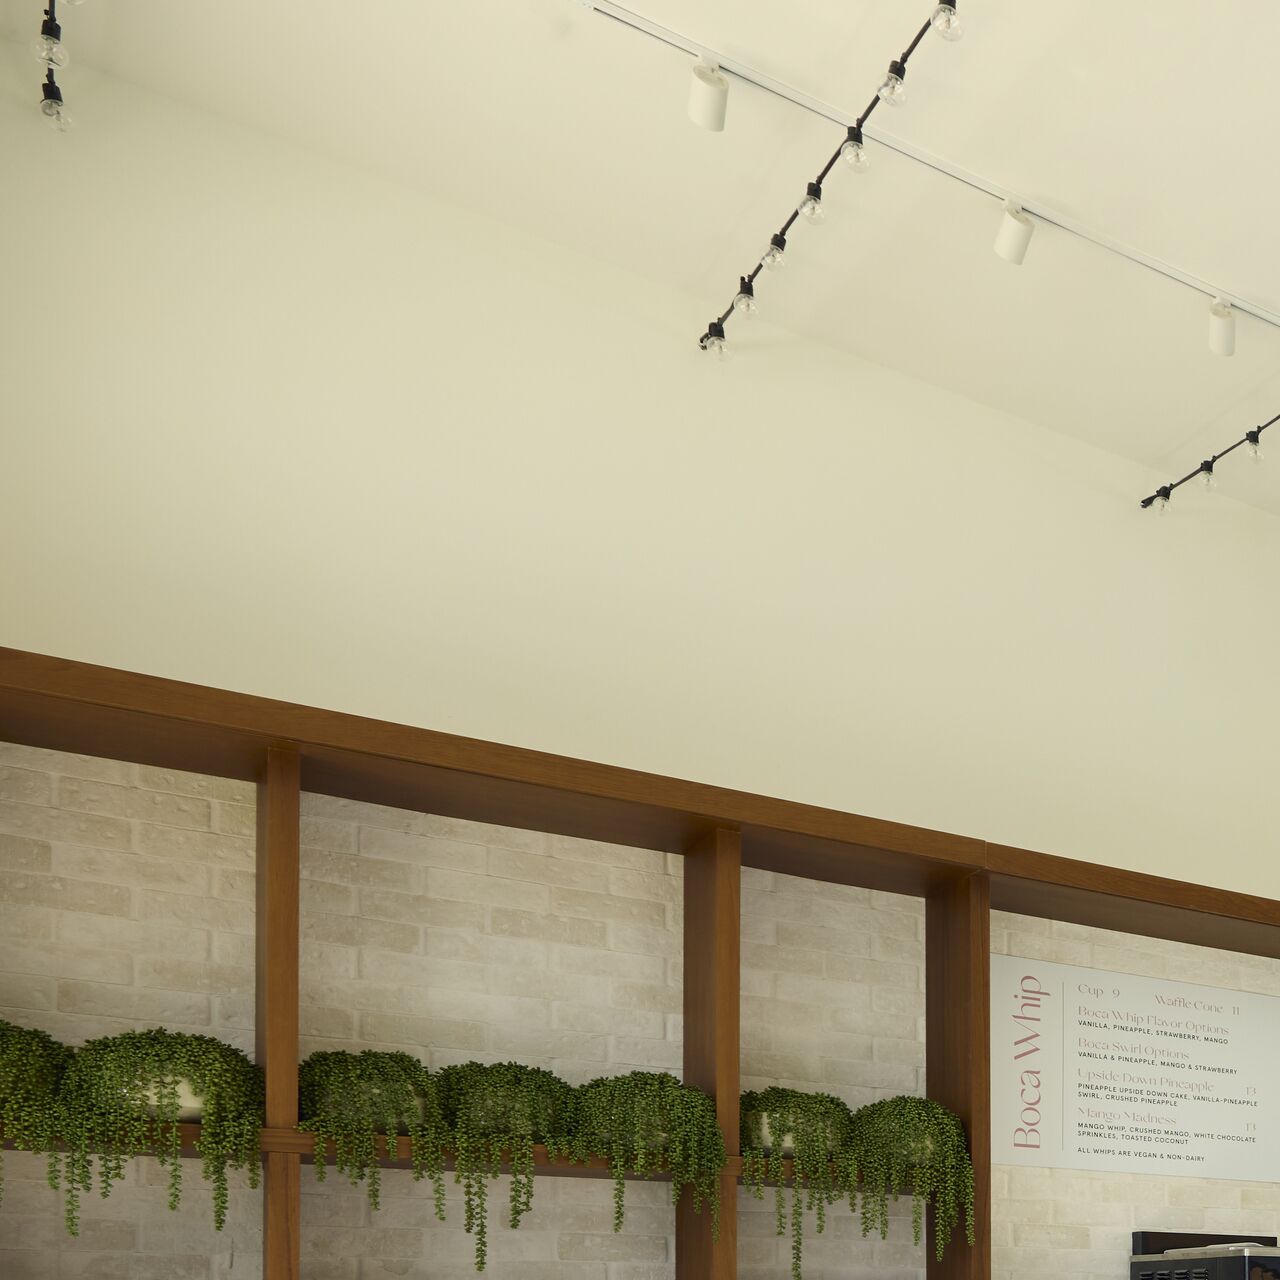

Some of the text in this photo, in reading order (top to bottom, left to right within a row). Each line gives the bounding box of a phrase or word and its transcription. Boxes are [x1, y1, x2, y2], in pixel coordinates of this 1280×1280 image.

[1077, 983, 1120, 1000] Cup 9
[1012, 975, 1051, 1148] Boca Whip
